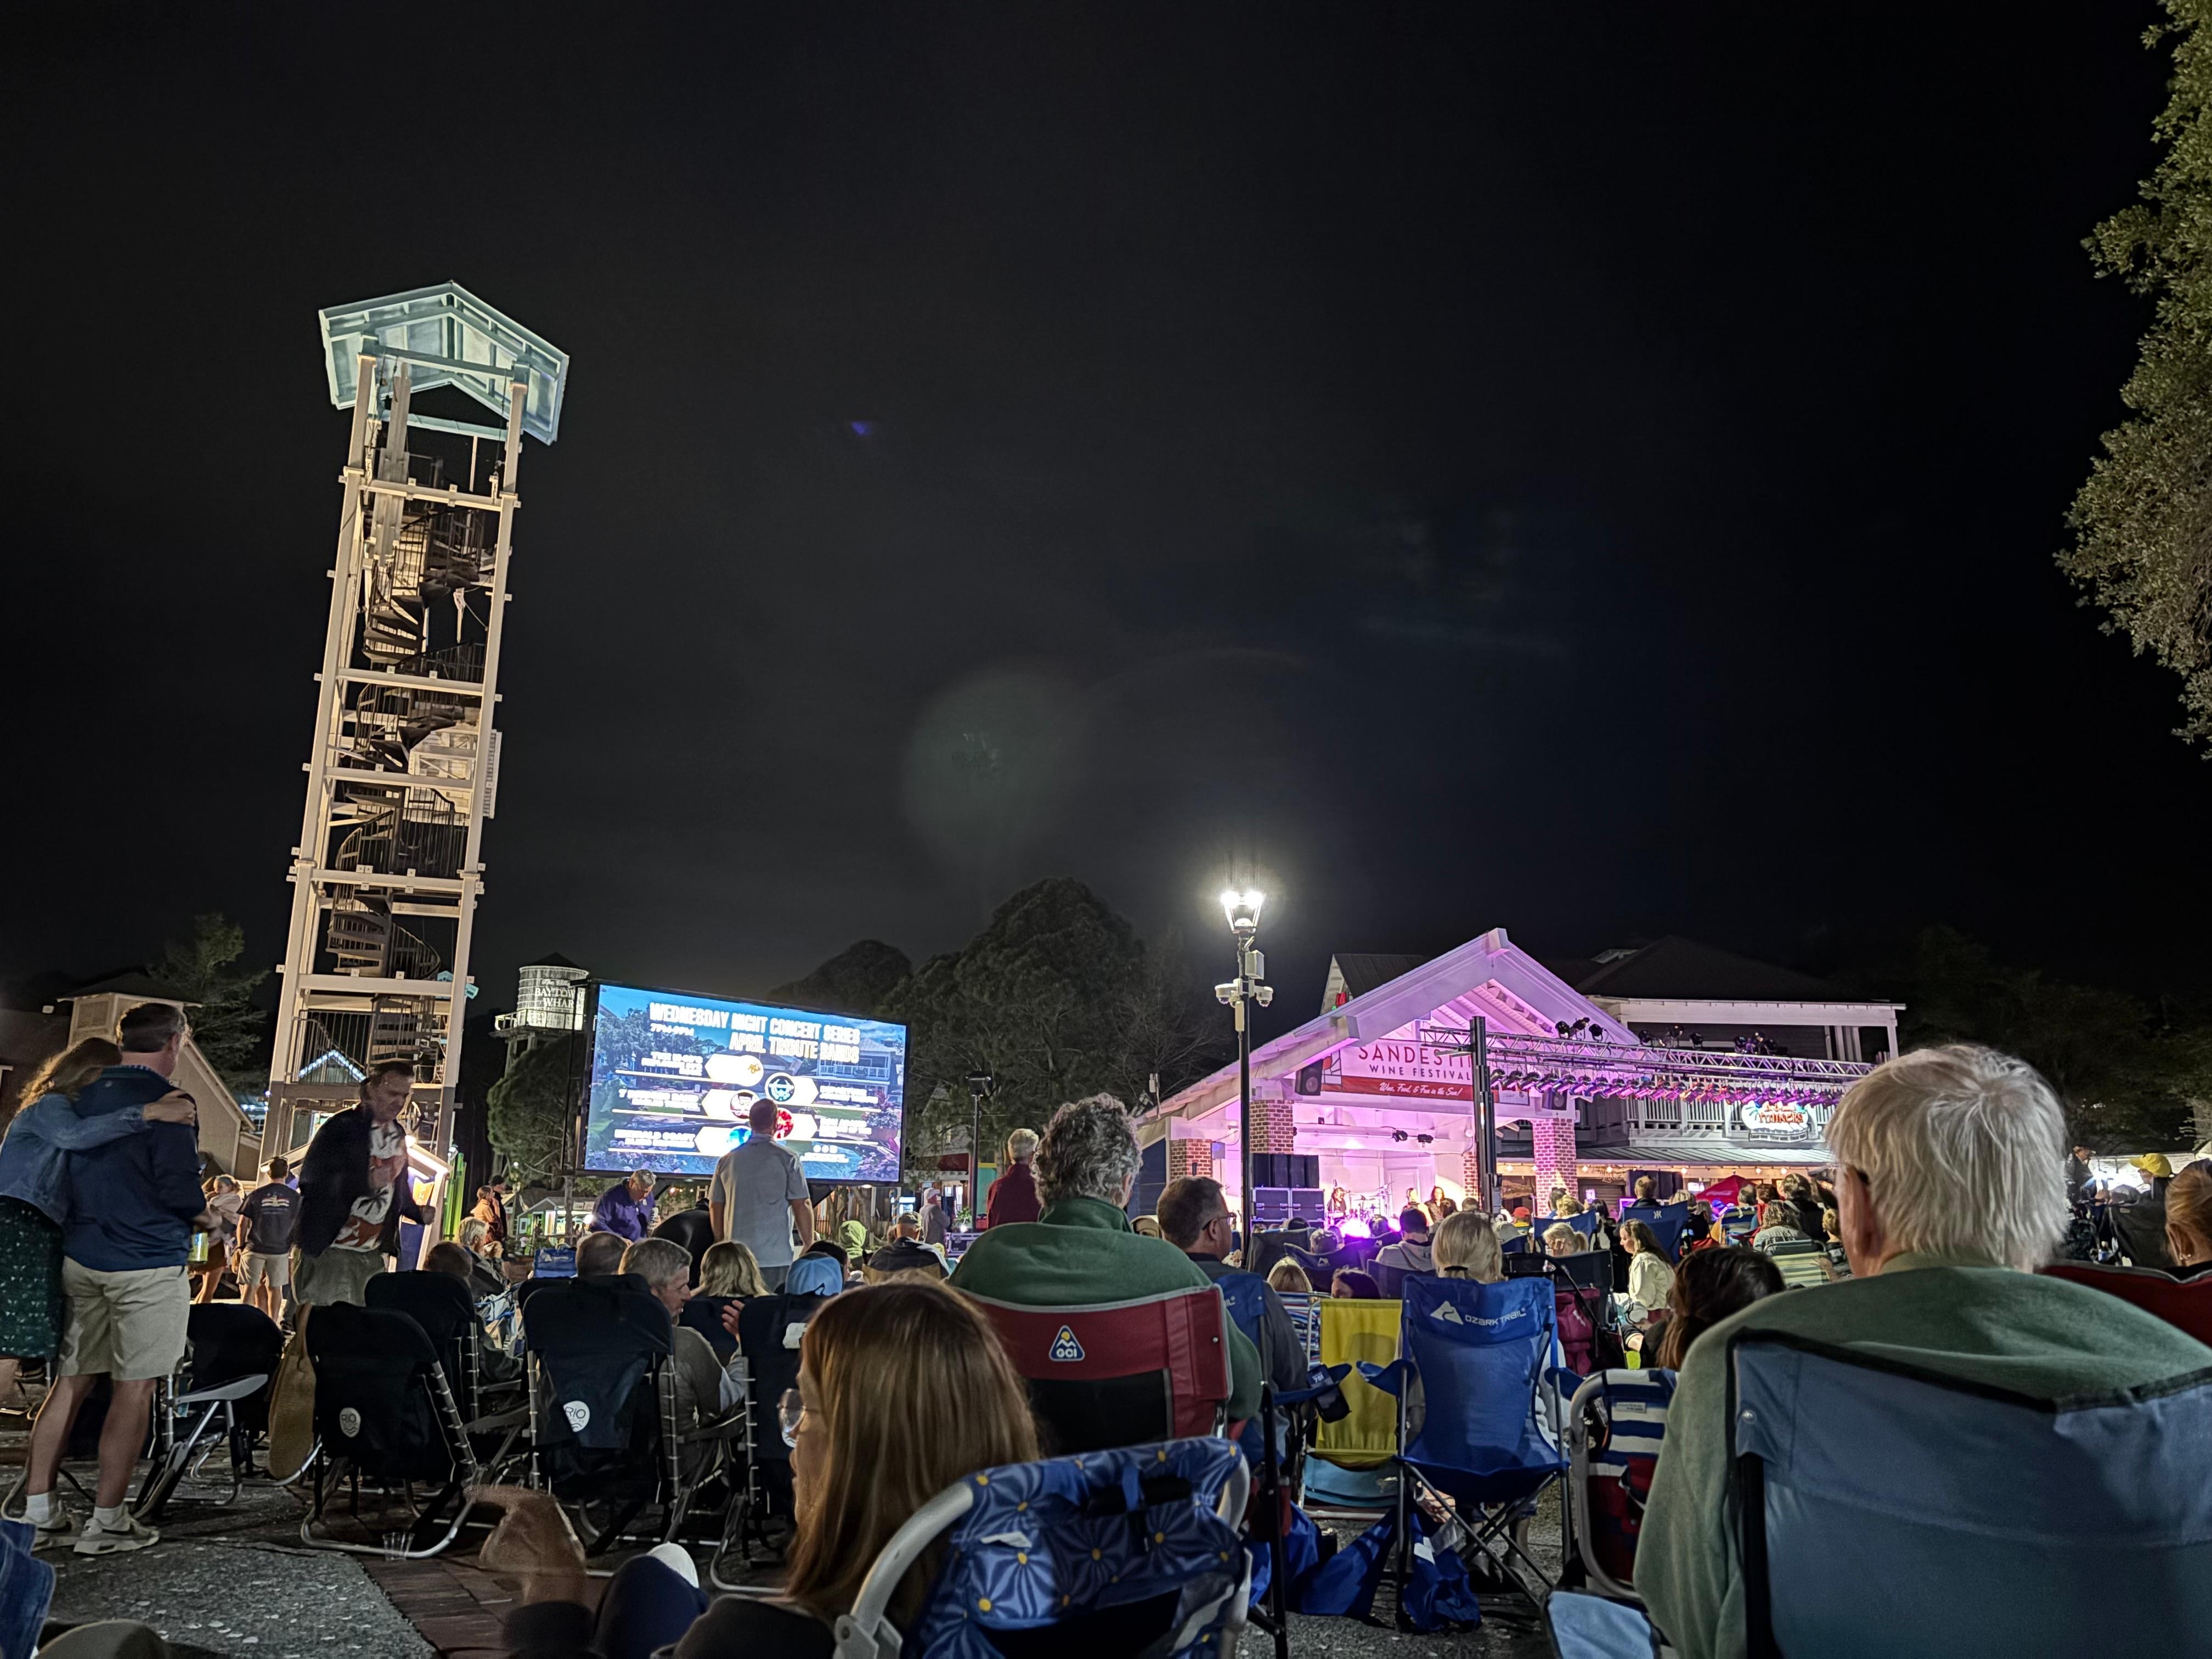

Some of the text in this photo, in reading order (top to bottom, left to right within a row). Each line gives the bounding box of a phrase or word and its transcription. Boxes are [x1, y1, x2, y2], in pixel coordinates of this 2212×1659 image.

[534, 987, 577, 1000] BAYTOW
[543, 997, 575, 1008] WHAR
[650, 1002, 860, 1045] WEDNESDAY NIGHT CONCERT SERIES
[729, 1031, 860, 1064] APRIL TRIBUTE BANDS
[1358, 1045, 1472, 1068] SANDESTI
[1369, 1064, 1471, 1081] WINE FESTIVAL
[1465, 1309, 1527, 1326] OZARK TRAIL
[341, 1413, 357, 1423] RIO
[565, 1407, 586, 1419] RIO
